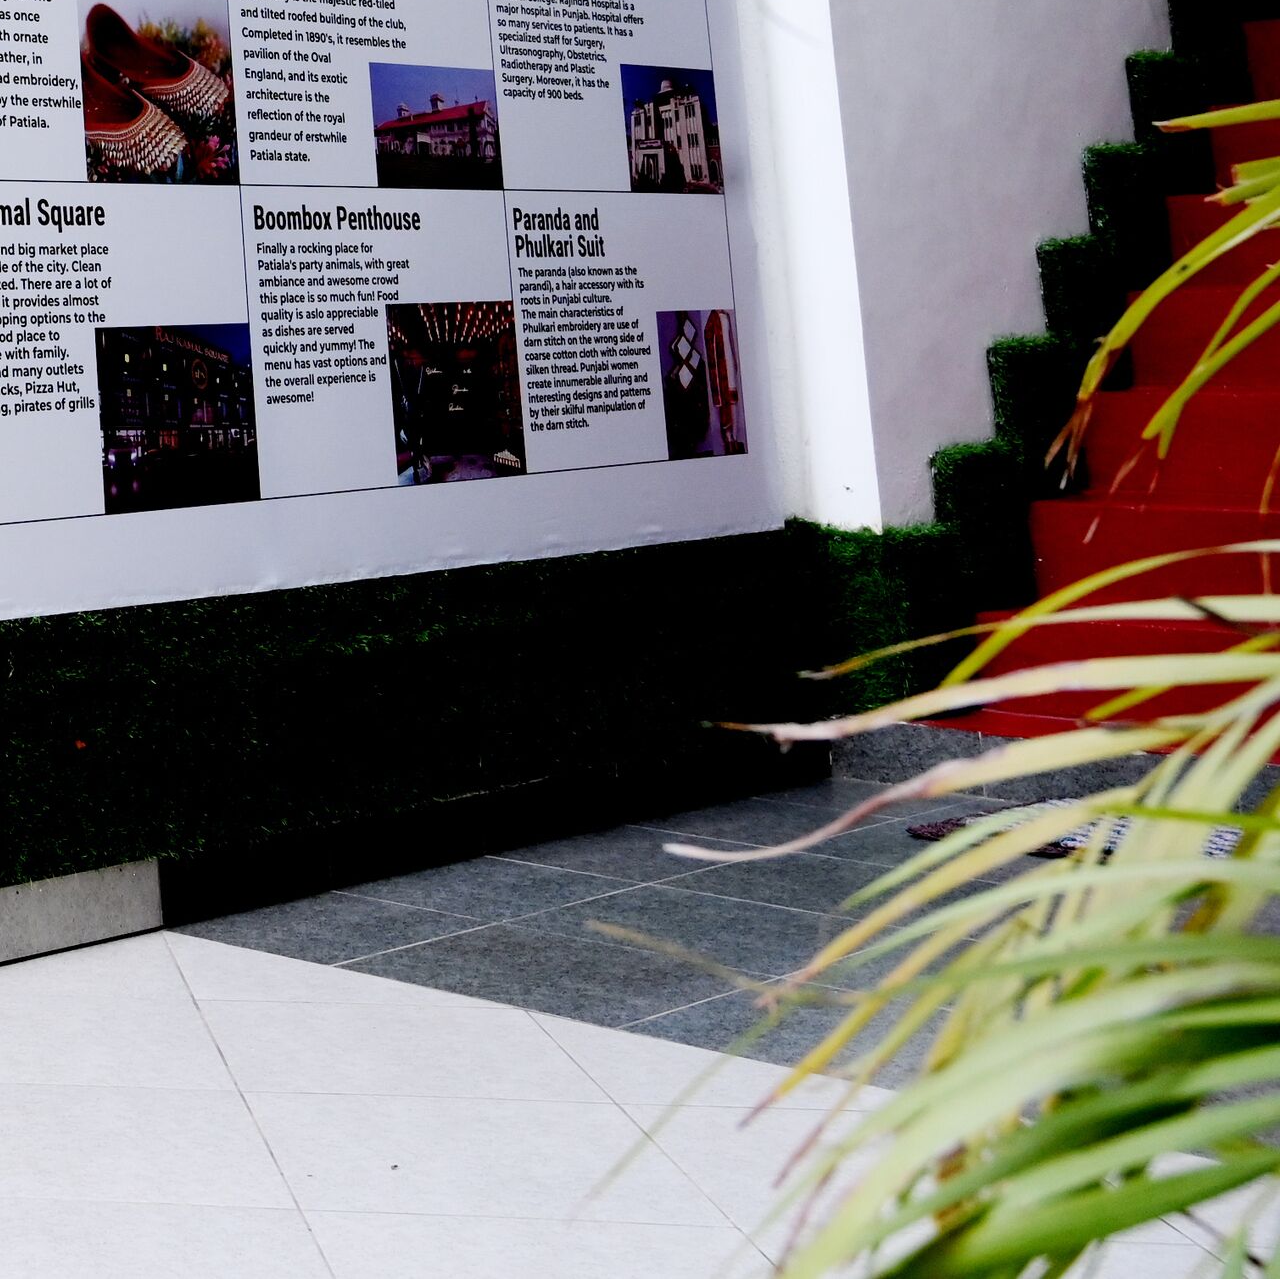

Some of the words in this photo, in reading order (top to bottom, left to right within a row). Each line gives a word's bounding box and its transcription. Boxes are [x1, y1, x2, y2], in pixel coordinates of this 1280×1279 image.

[498, 31, 541, 43] specialized
[543, 34, 560, 44] staff
[561, 35, 572, 45] for
[13, 73, 78, 90] embroidery,
[503, 87, 536, 100] capacity
[537, 88, 545, 98] of
[546, 88, 562, 99] 900
[250, 149, 282, 161] Patiala
[37, 199, 105, 233] Square
[253, 204, 332, 230] Boombox
[336, 205, 420, 230] Penthouse
[512, 207, 571, 230] Paranda
[574, 207, 599, 231] and
[514, 233, 573, 257] Phulkari
[577, 234, 605, 257] Suit
[260, 308, 293, 323] quality
[295, 307, 303, 320] is
[305, 308, 324, 319] aslo
[326, 306, 378, 321] appreciable
[25, 381, 54, 394] Pizza
[56, 381, 80, 393] Hut,
